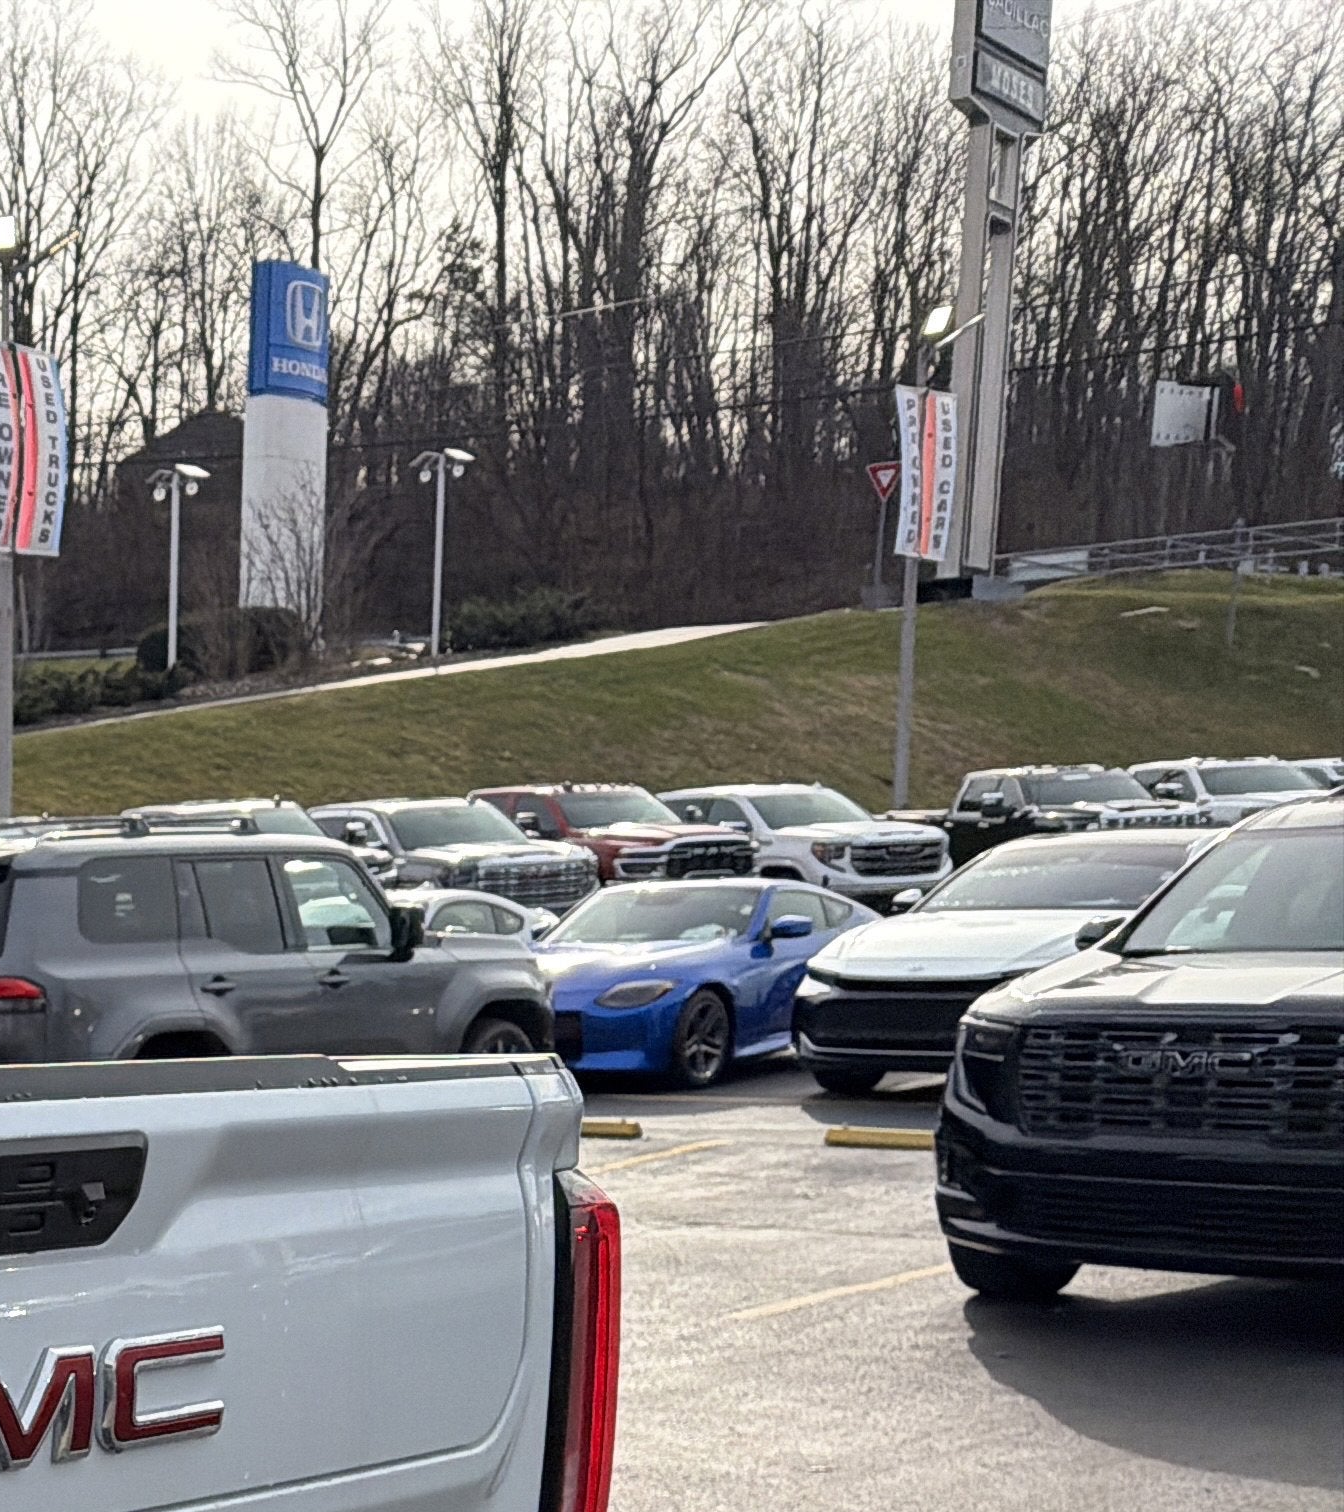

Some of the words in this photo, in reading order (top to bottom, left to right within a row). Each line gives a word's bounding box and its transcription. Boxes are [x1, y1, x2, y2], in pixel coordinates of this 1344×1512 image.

[36, 357, 58, 424] USED
[271, 356, 328, 384] HONDA
[941, 401, 952, 468] USED
[38, 436, 60, 544] TRUCKS
[933, 480, 951, 549] CARS
